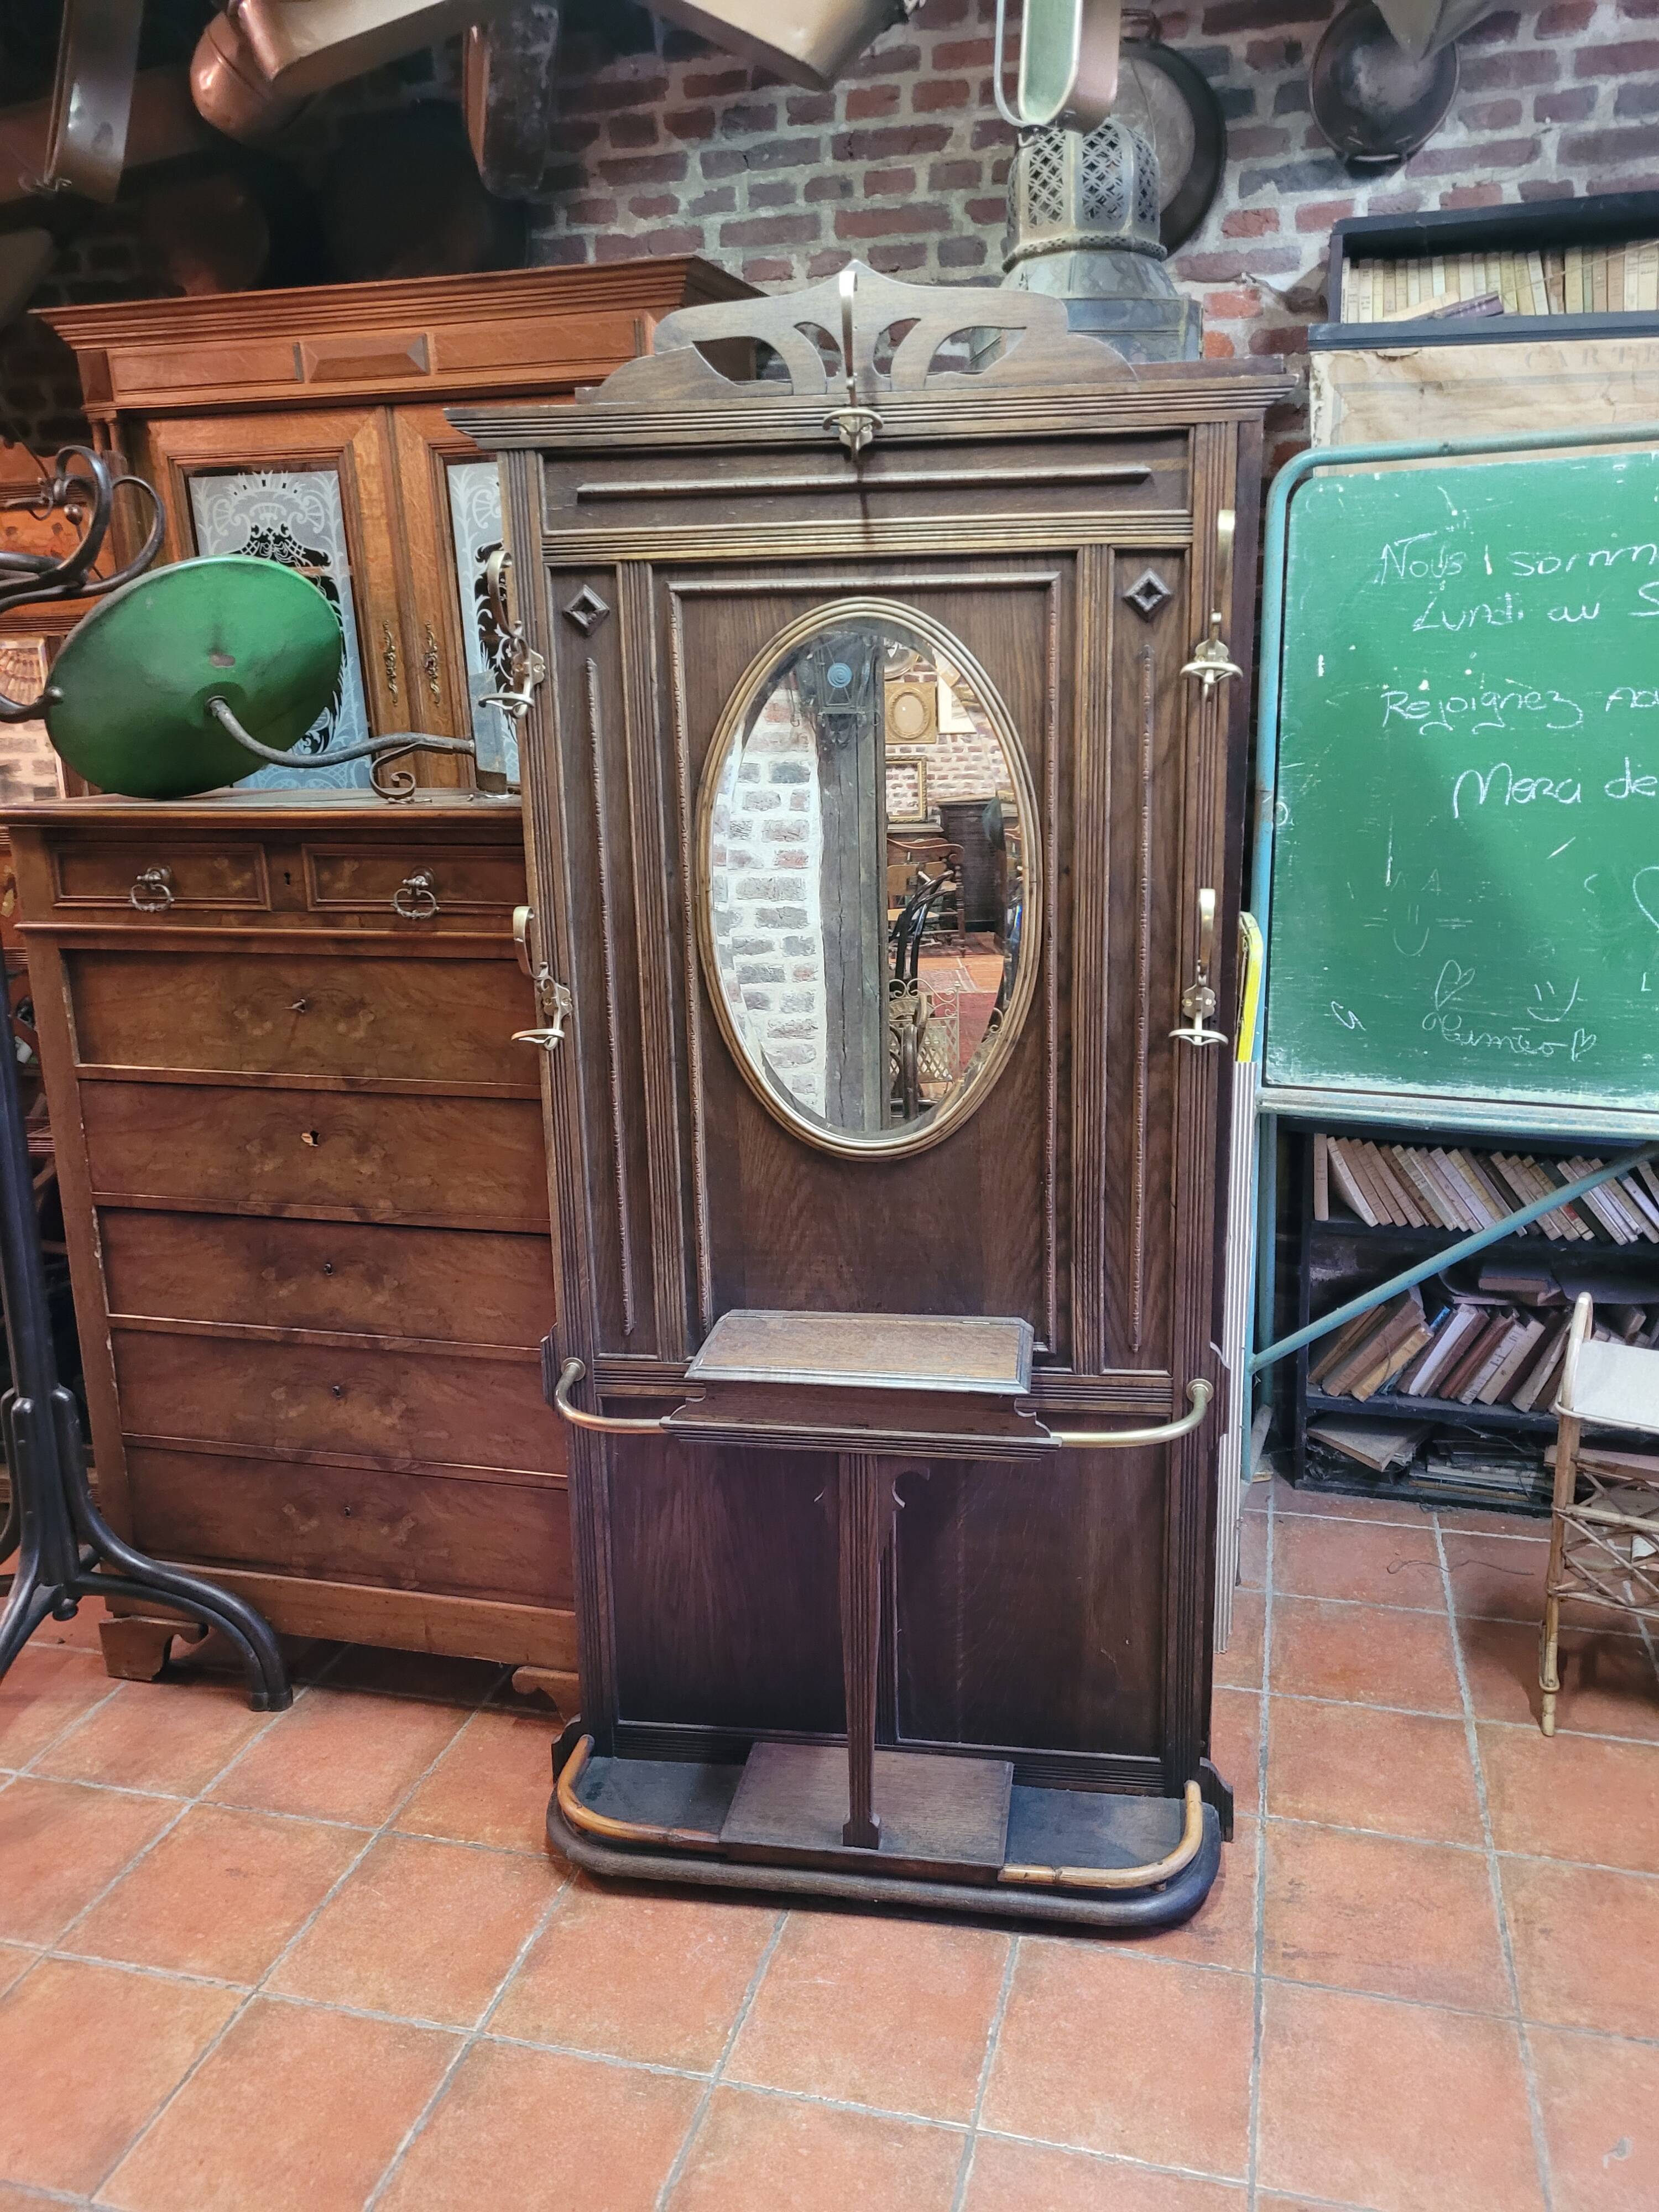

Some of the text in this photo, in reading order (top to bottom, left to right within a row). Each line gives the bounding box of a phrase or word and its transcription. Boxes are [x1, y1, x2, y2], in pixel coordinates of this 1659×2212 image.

[1381, 531, 1466, 586] Nous
[1412, 592, 1524, 632] Lundi
[1547, 602, 1600, 622] au
[1381, 690, 1583, 735] Rejoignez
